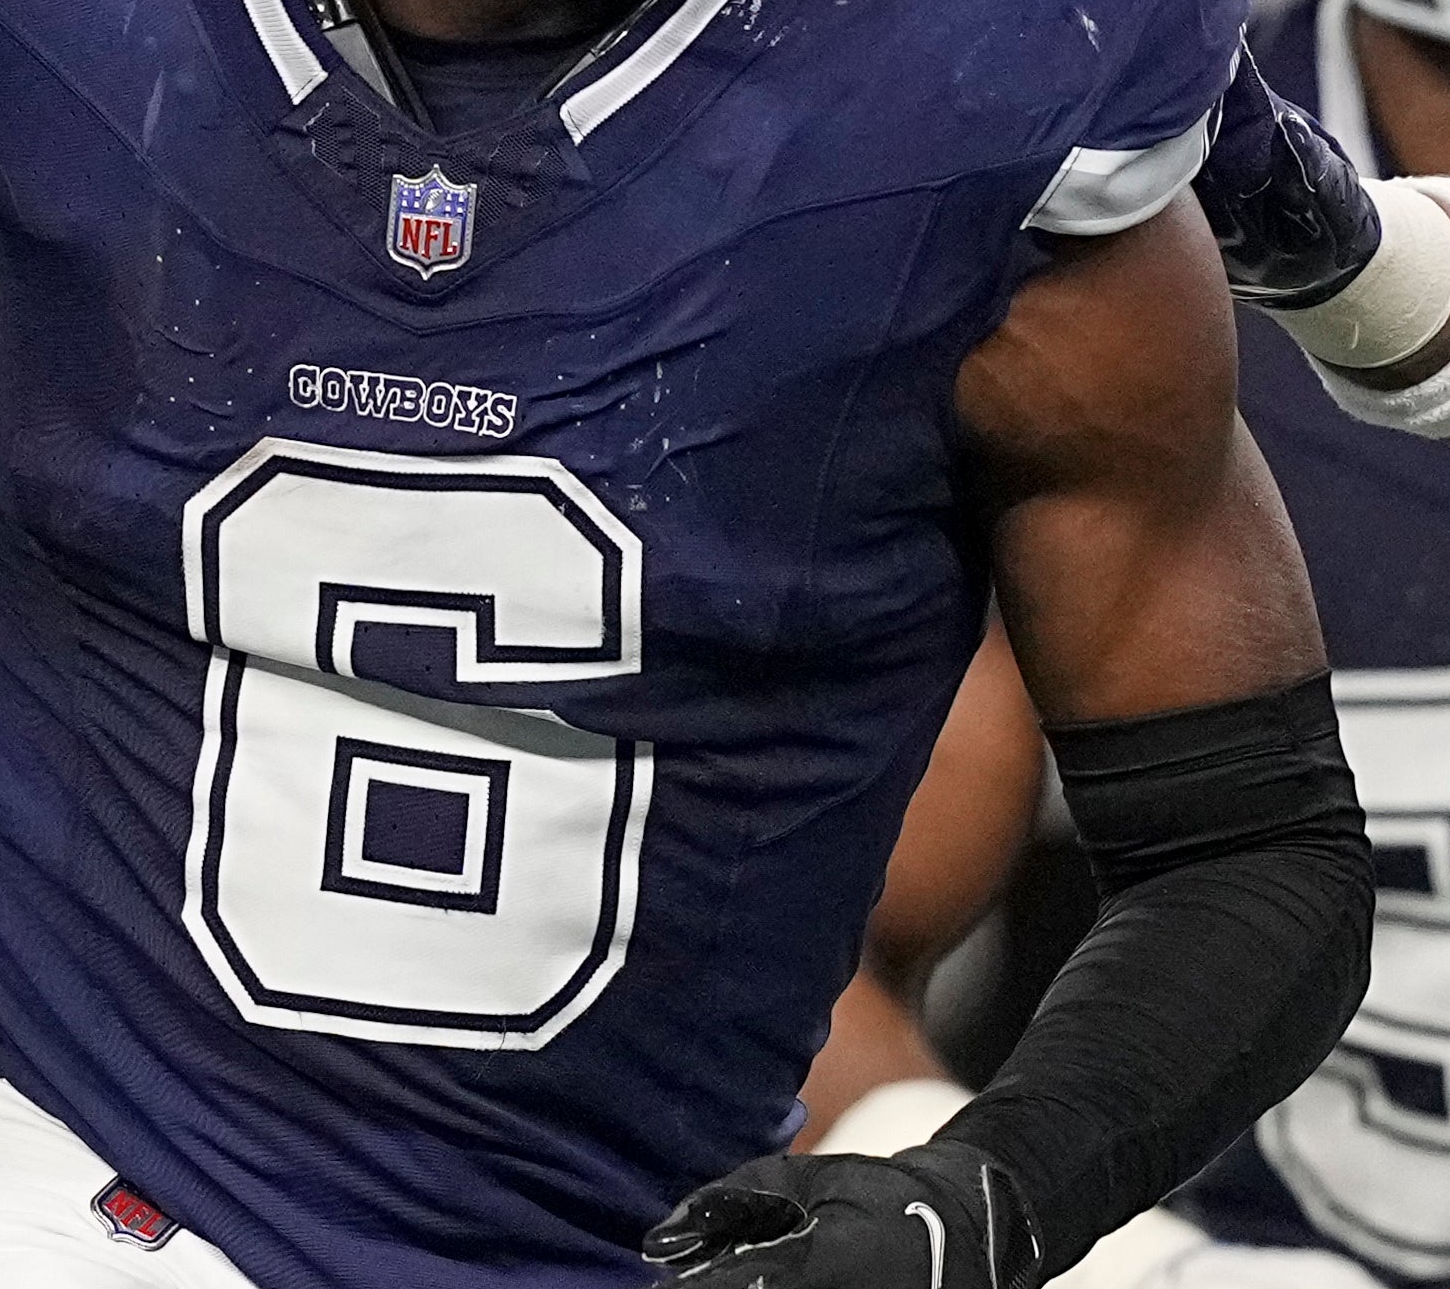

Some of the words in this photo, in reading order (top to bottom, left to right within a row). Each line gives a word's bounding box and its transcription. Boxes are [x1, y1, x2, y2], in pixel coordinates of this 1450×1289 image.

[399, 217, 458, 261] NFL
[287, 363, 518, 439] COWBOYS
[182, 436, 654, 1051] 6
[104, 1189, 162, 1238] NFL
